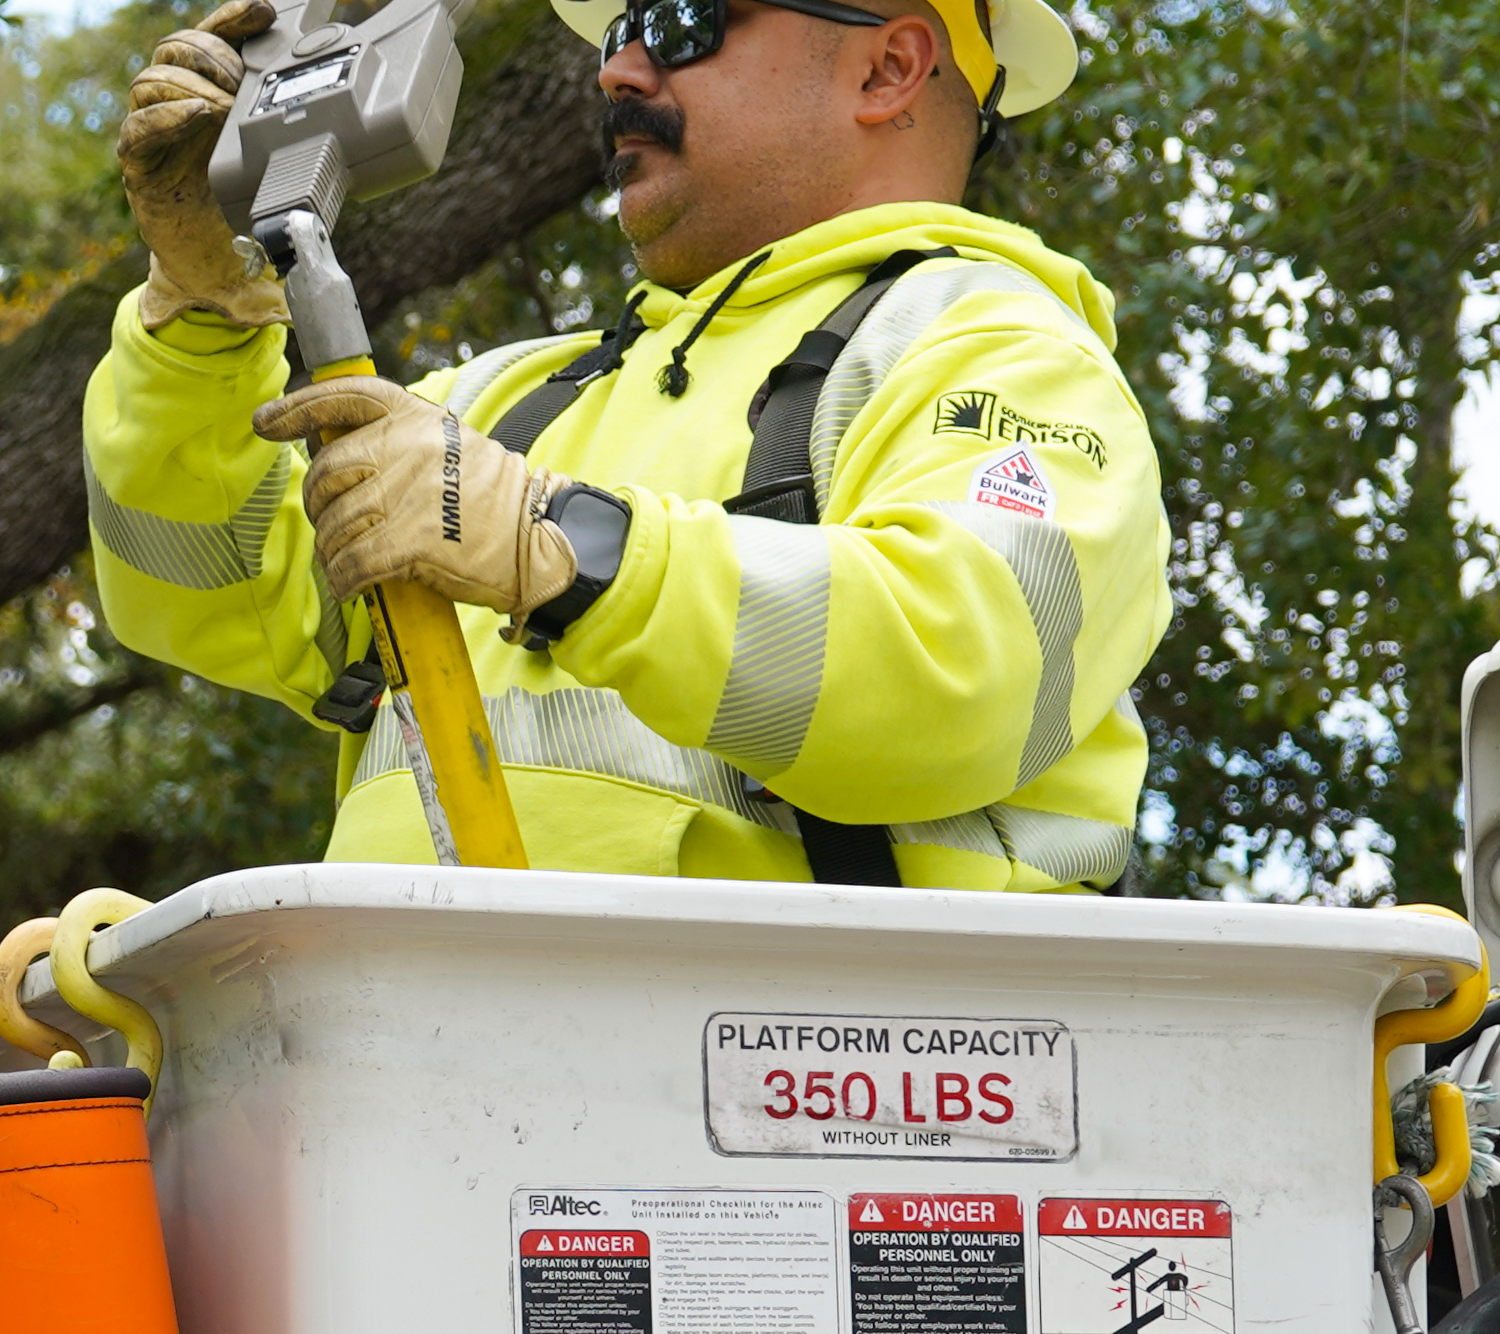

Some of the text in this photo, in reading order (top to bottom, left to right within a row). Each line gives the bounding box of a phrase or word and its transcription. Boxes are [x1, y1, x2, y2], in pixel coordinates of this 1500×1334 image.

[998, 417, 1107, 471] EDISON
[441, 407, 462, 544] YOUNGSTOWN
[980, 477, 1048, 509] Bulwark
[981, 493, 999, 505] FR
[718, 1024, 1062, 1057] PLATFORM CAPACITY
[763, 1069, 1014, 1125] 350 LBS
[822, 1130, 951, 1147] WITHOUT LINER
[550, 1195, 601, 1216] Altec
[632, 1199, 823, 1210] Preoperational Checklist for the Altec
[902, 1201, 996, 1222] DANGER
[632, 1209, 651, 1218] Unit
[656, 1210, 699, 1219] Installed
[720, 1210, 738, 1219] this
[1097, 1207, 1205, 1230] DANGER
[558, 1235, 634, 1252] DANGER
[853, 1233, 1020, 1246] OPERATION BY QUALIFIED
[522, 1258, 649, 1269] OPERATION BY QUALIFIED
[879, 1249, 996, 1262] PERSONNEL ONLY
[542, 1270, 630, 1280] PERSONNEL ONLY
